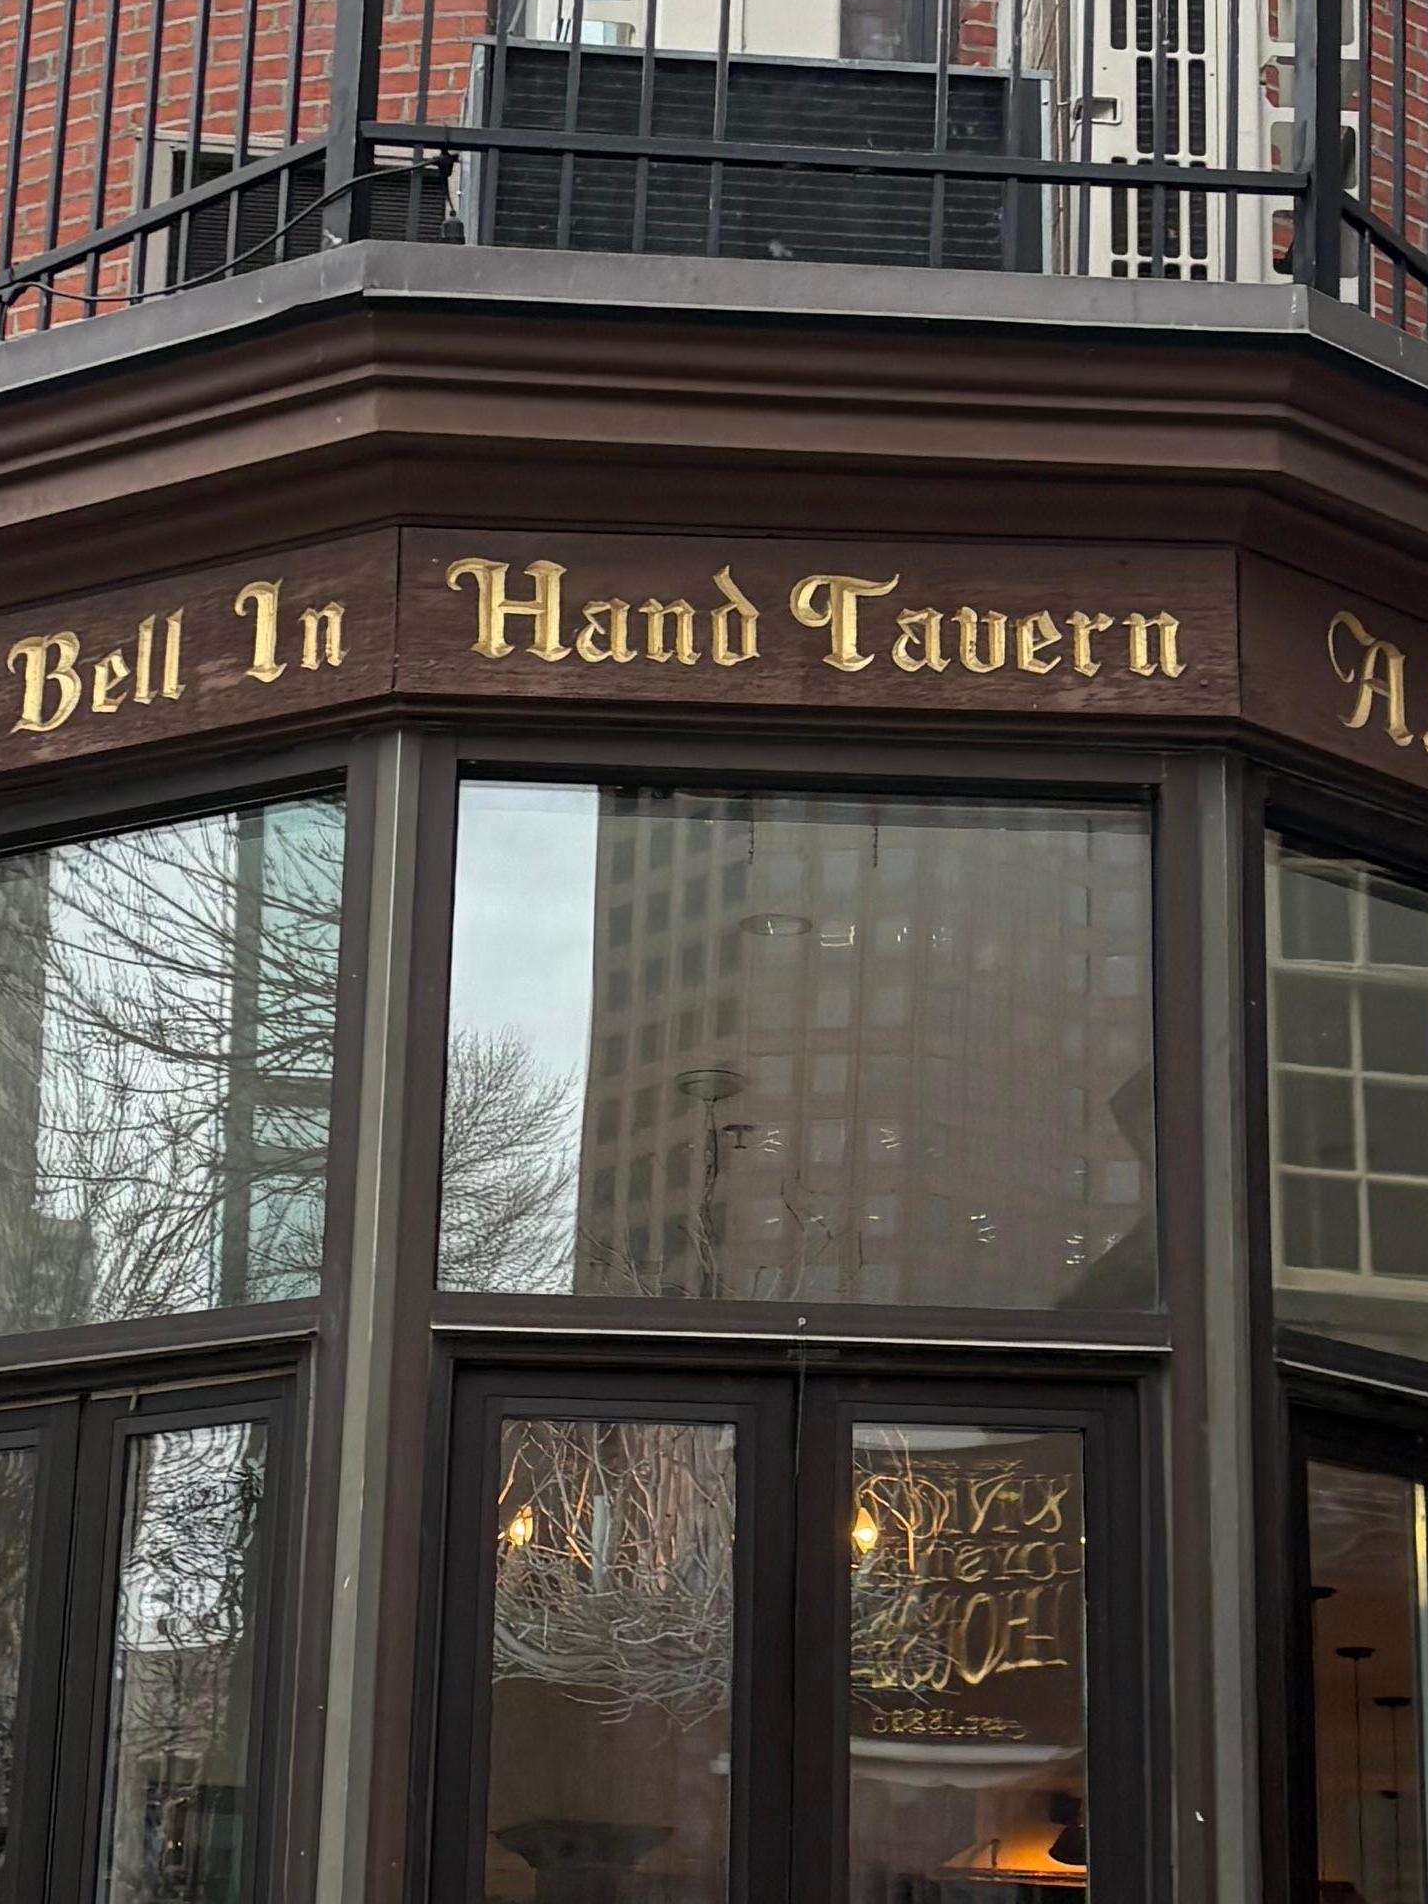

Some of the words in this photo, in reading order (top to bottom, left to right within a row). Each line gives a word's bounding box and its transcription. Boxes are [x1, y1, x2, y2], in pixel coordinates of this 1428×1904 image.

[6, 607, 187, 735] Bell
[234, 577, 349, 684] In
[445, 557, 761, 668] Hand
[789, 572, 1187, 679] Tavern
